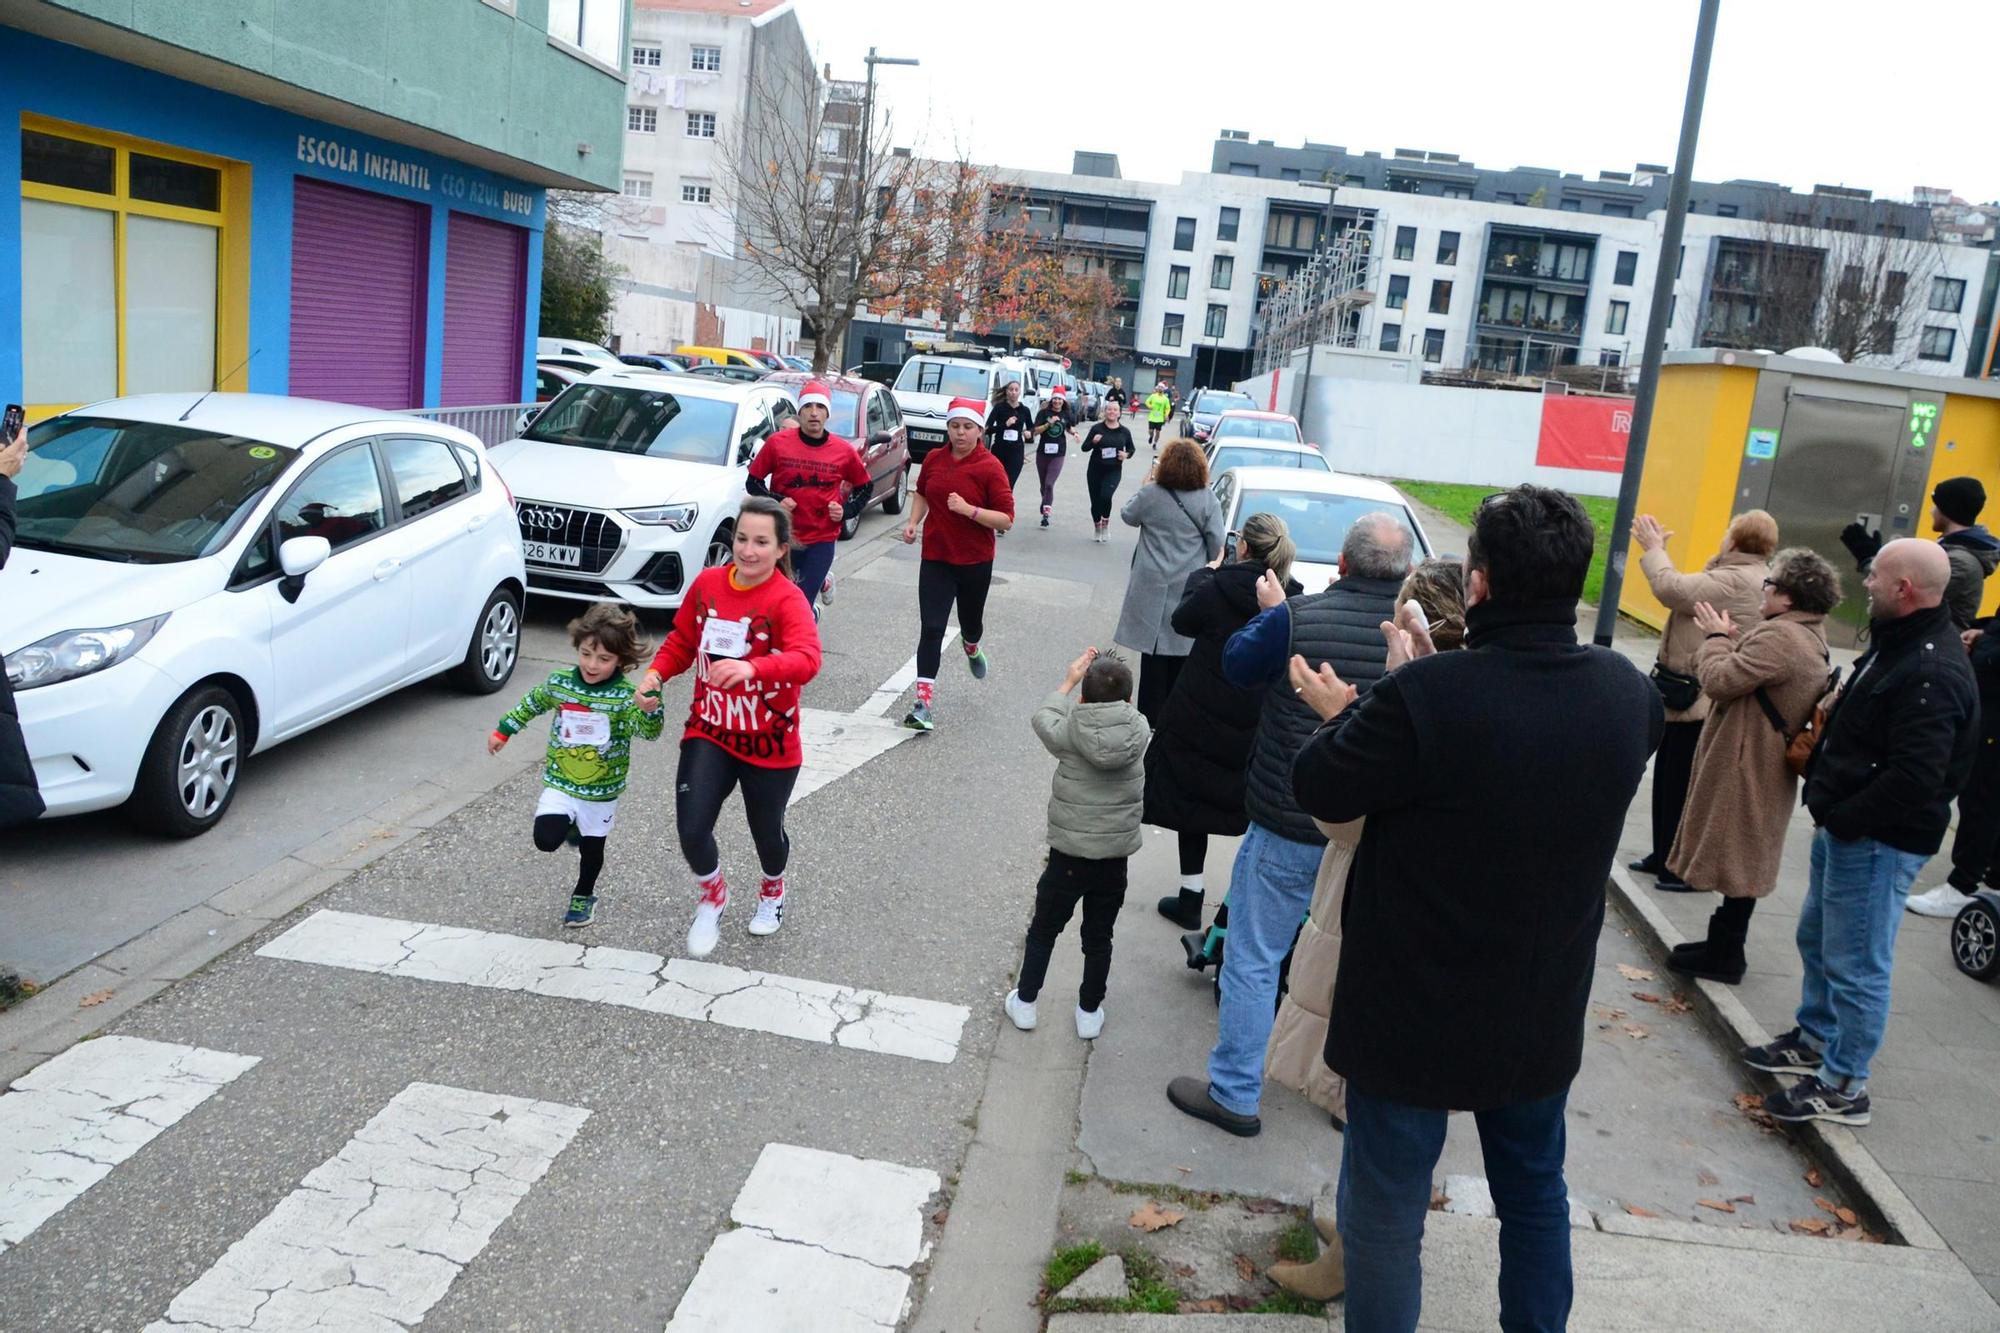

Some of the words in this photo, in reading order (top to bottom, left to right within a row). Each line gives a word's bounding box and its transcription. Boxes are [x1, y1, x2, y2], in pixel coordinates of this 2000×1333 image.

[297, 135, 358, 173] ESCOLA
[364, 152, 431, 191] INFANTIL
[469, 181, 499, 207] AZUL
[503, 190, 533, 216] BUEU
[1912, 402, 1937, 418] WC
[549, 547, 576, 562] KWV
[726, 694, 759, 730] MY
